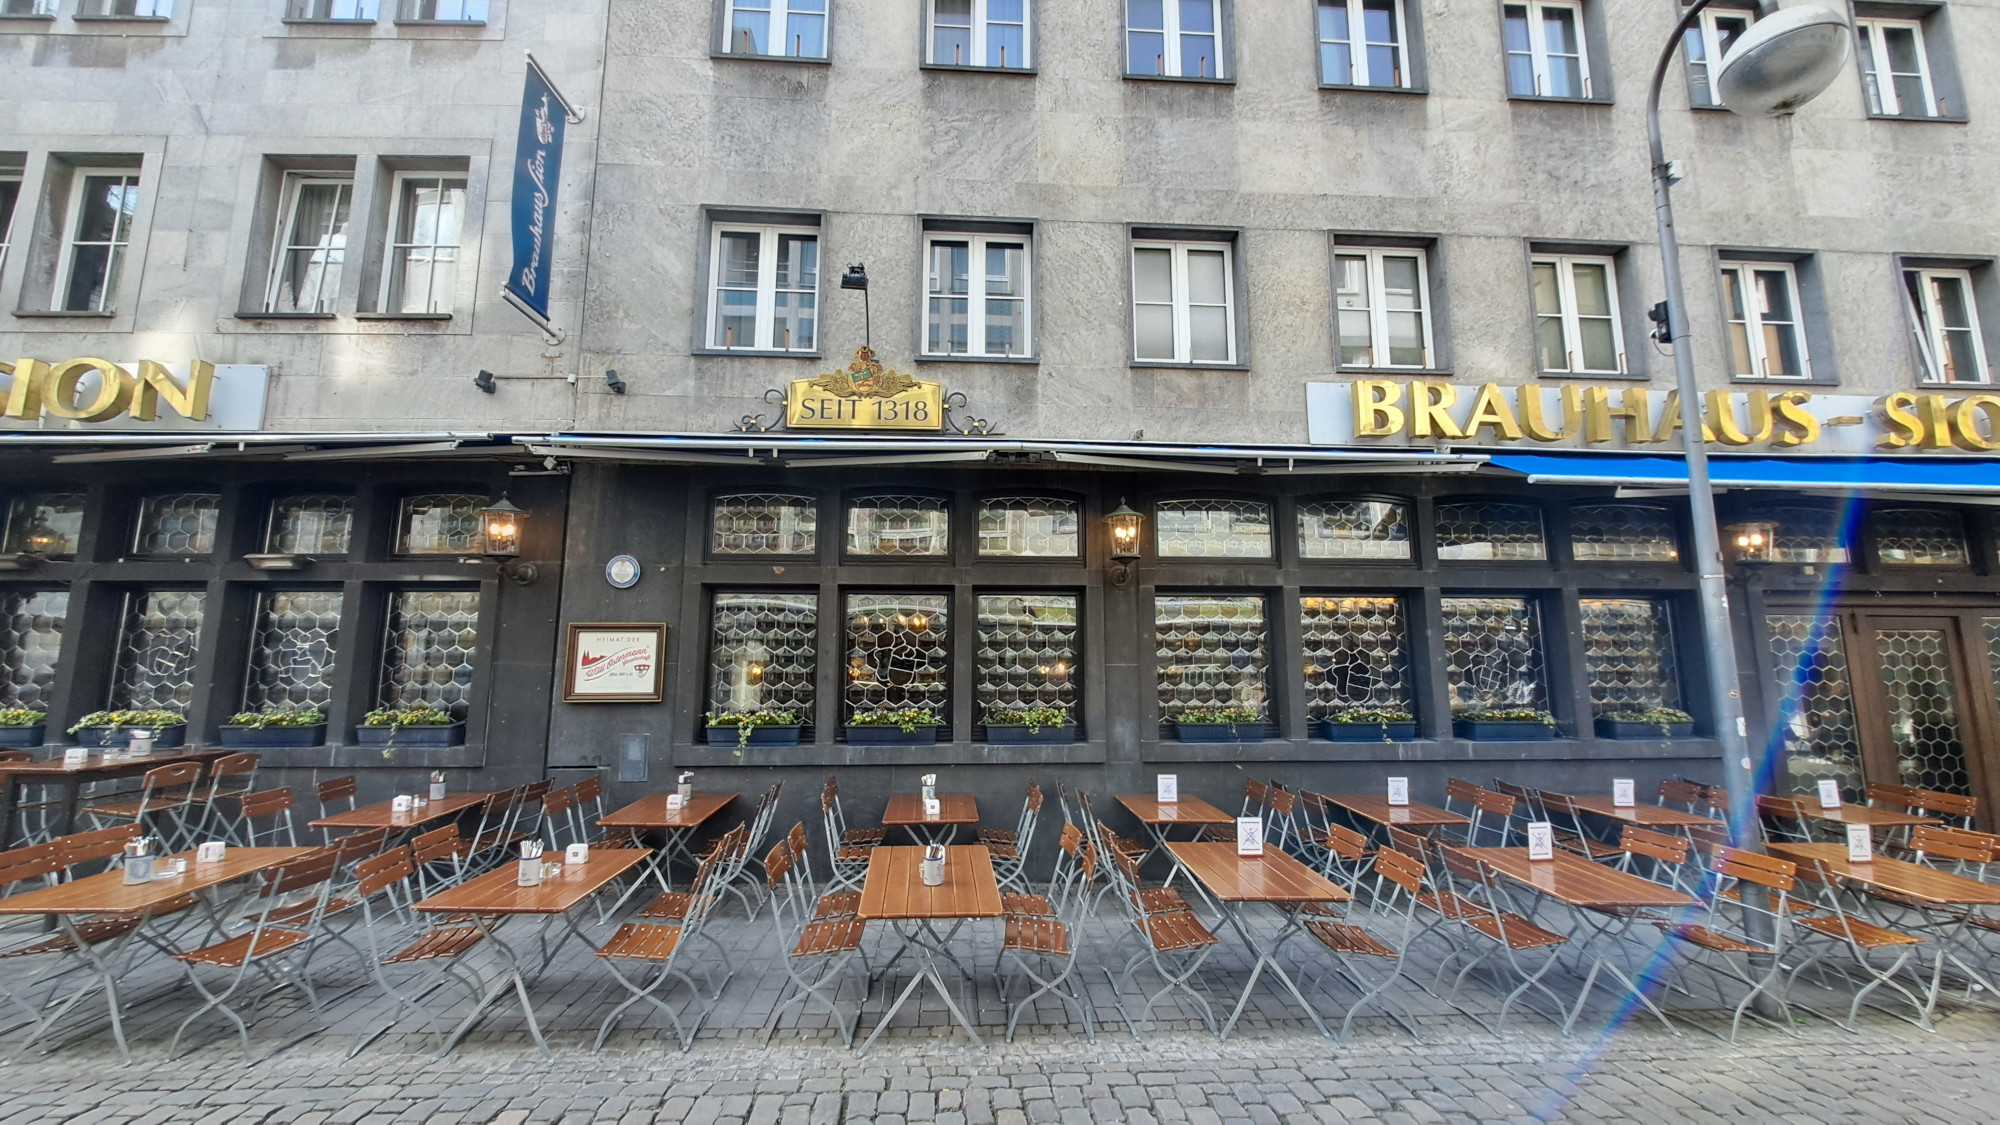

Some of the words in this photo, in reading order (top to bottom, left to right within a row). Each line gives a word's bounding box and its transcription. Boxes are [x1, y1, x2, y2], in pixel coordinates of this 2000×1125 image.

[522, 191, 544, 297] Brauhaus
[0, 357, 216, 422] ION
[800, 397, 863, 420] SEIT
[871, 400, 929, 422] 1318
